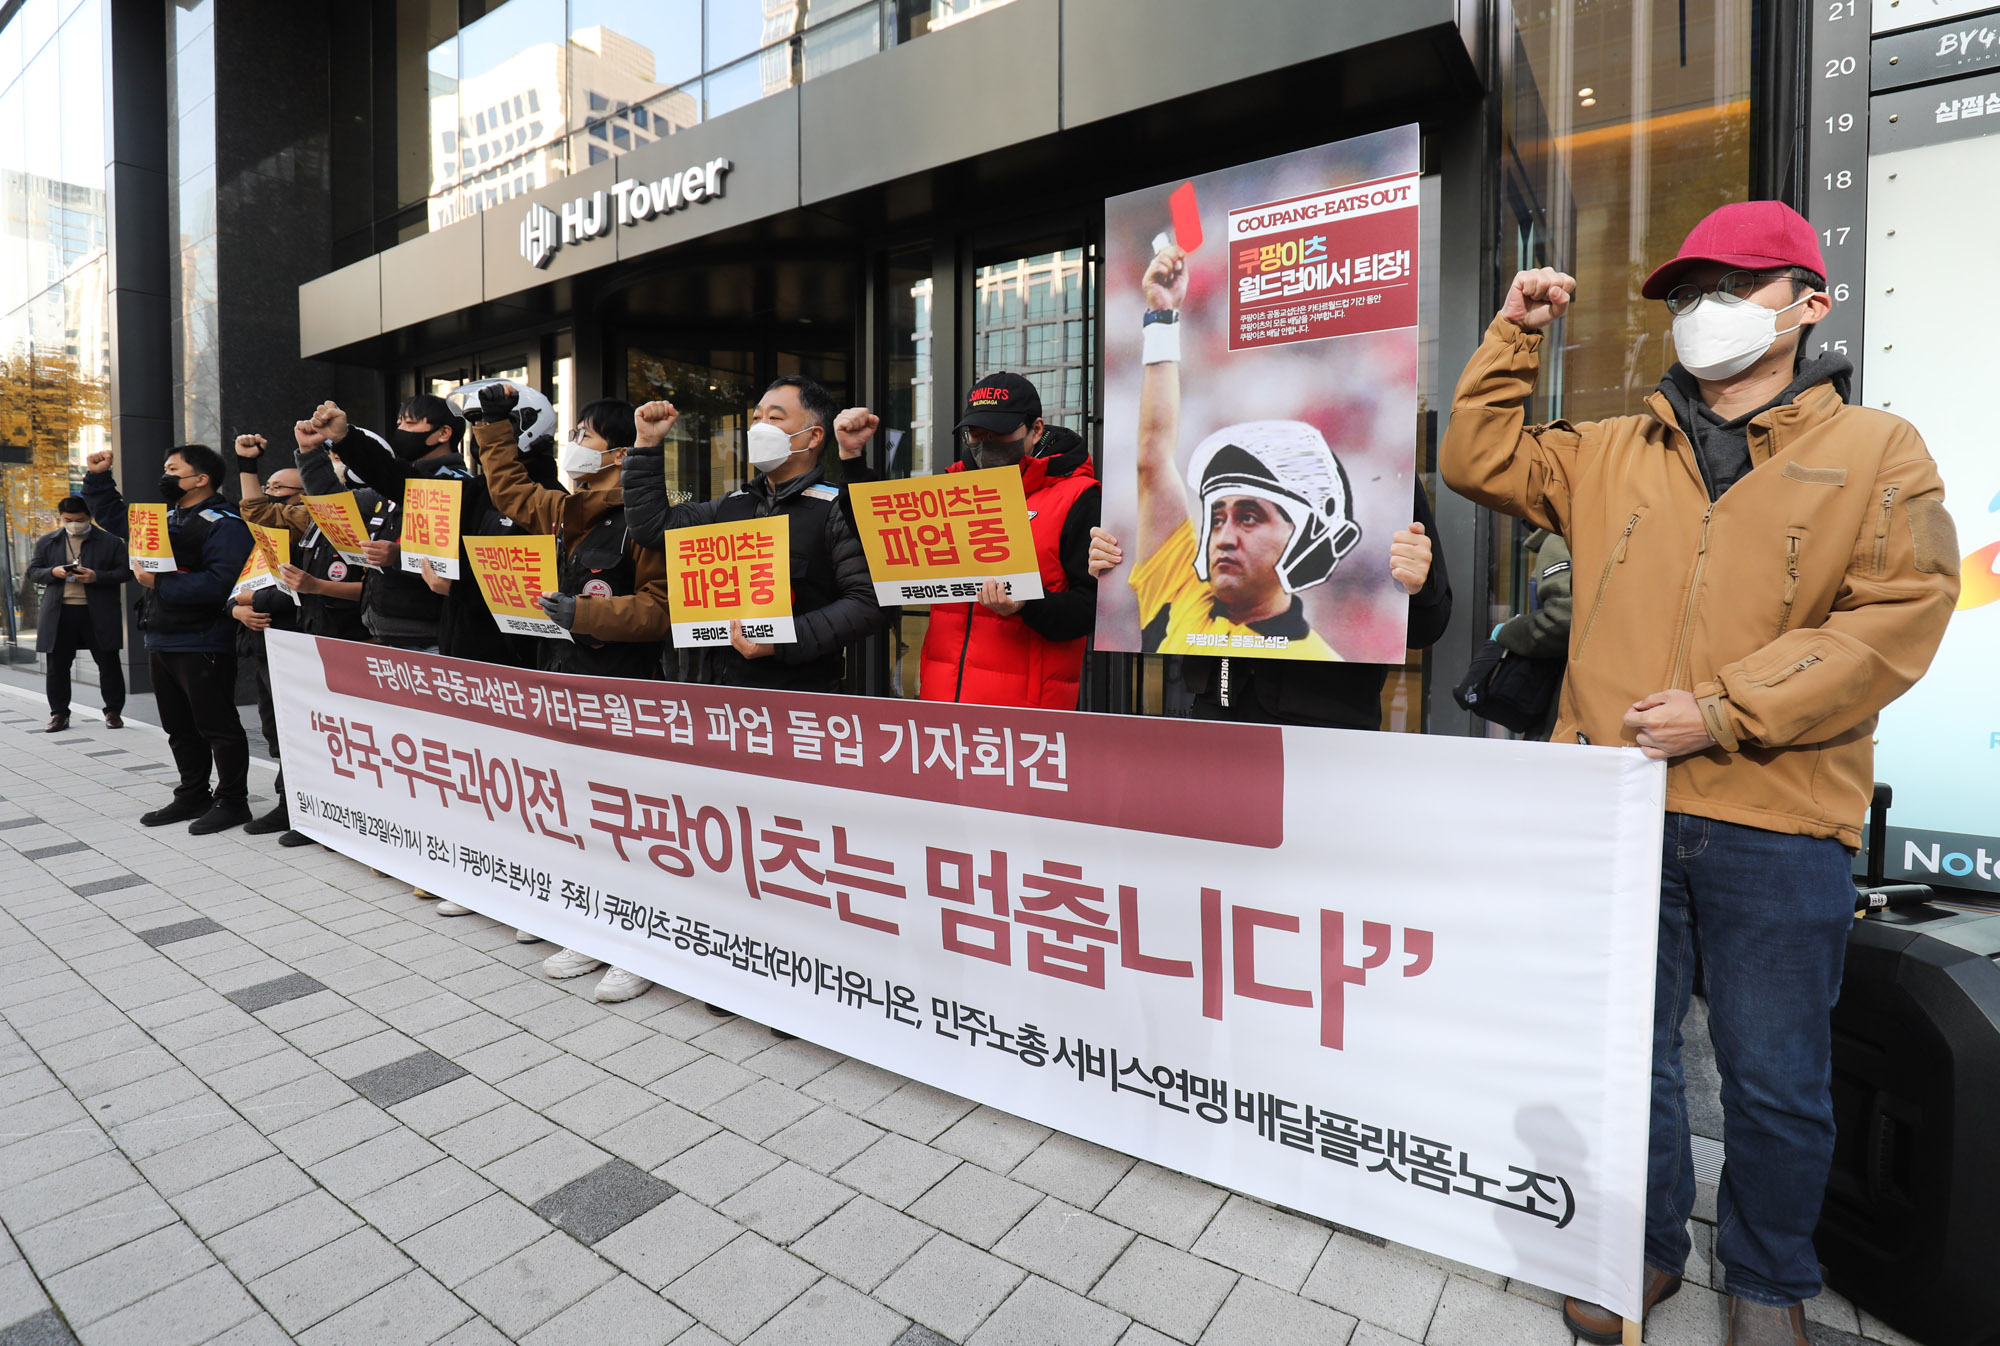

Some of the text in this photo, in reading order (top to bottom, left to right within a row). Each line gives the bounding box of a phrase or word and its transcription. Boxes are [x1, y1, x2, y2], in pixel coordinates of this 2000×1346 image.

[1829, 1, 1855, 21] 21
[1825, 57, 1856, 79] 20
[1825, 113, 1854, 134] 19
[1823, 170, 1852, 190] 18
[562, 156, 729, 244] HJ Tower
[1237, 185, 1411, 233] COUPANG-EATS OUT
[1823, 227, 1851, 247] 17
[1238, 235, 1328, 274] 쿠팡이츠
[1238, 249, 1410, 304] 월드컵에서 퇴장!
[1240, 294, 1382, 323] 쿠팡이츠 공동교섭단은 카타르월드컵 기간 동안
[1240, 309, 1346, 332] 쿠팡이츠의 모든 배달을 거부합니다.
[1240, 323, 1310, 342] 쿠팡이츠 배달 안합니다.
[406, 488, 451, 512] 쿠팡이츠는
[871, 484, 1002, 523] 쿠팡이츠는
[146, 527, 160, 551] 중
[405, 512, 449, 548] 파업 중
[878, 518, 1010, 567] 파업 중
[474, 547, 541, 573] 쿠팡이츠는
[679, 531, 775, 567] 쿠팡이츠는
[482, 573, 527, 609] 파업
[522, 575, 544, 611] 중
[680, 562, 775, 608] 파업 중
[901, 584, 949, 599] 쿠팡이츠
[692, 626, 729, 641] 쿠팡이츠
[1186, 633, 1289, 649] 쿠팡이츠 공동교섭단
[365, 656, 1069, 792] 쿠팡이츠 공동교섭단 카타르월드컵 파업 돌입 기자회견
[587, 780, 907, 936] 쿠팡이츠는
[925, 845, 1434, 1051] 멈춥니다”
[297, 791, 315, 817] 일시
[321, 800, 350, 829] 2022년
[350, 810, 367, 836] 11월
[367, 816, 404, 848] 23일(수)
[404, 829, 422, 856] 11시
[426, 835, 450, 863] 장소
[560, 879, 591, 916] 주최
[931, 996, 1049, 1068] 민주노총
[1052, 1036, 1228, 1124] 서비스연맹
[1234, 1088, 1576, 1230] 배달플랫폼노조)
